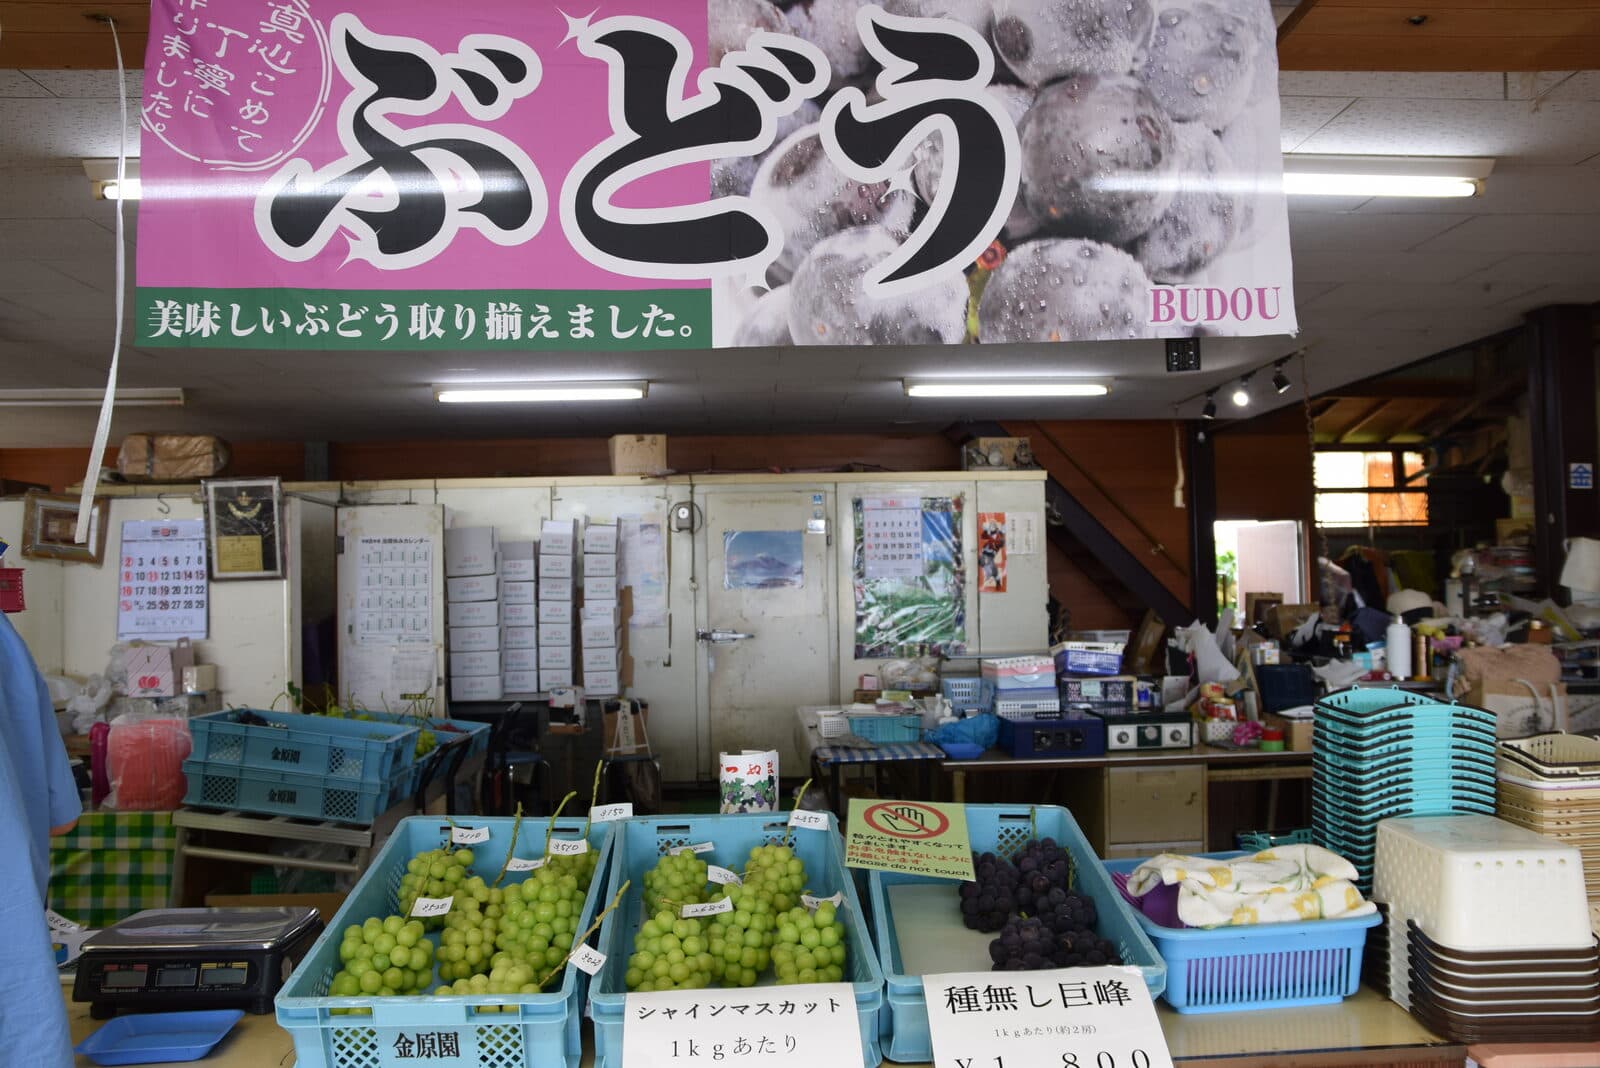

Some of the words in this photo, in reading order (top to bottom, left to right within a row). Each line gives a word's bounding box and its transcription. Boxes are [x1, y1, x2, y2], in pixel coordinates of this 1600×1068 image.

[231, 1, 304, 152] 真心こめて
[259, 9, 1017, 294] ぶどう
[147, 299, 692, 342] 美味しいぶどう取り揃えました。
[1149, 286, 1281, 323] BUDOU
[847, 857, 888, 867] Please
[890, 861, 907, 870] do
[909, 865, 931, 873] not
[934, 868, 970, 877] touch
[848, 844, 971, 863] お手を触れないように
[637, 997, 841, 1020] シャインマスカット
[943, 979, 1133, 1015] 種無し巨峰
[392, 1031, 460, 1059] 金原園
[671, 1034, 797, 1061] 1kgあたり
